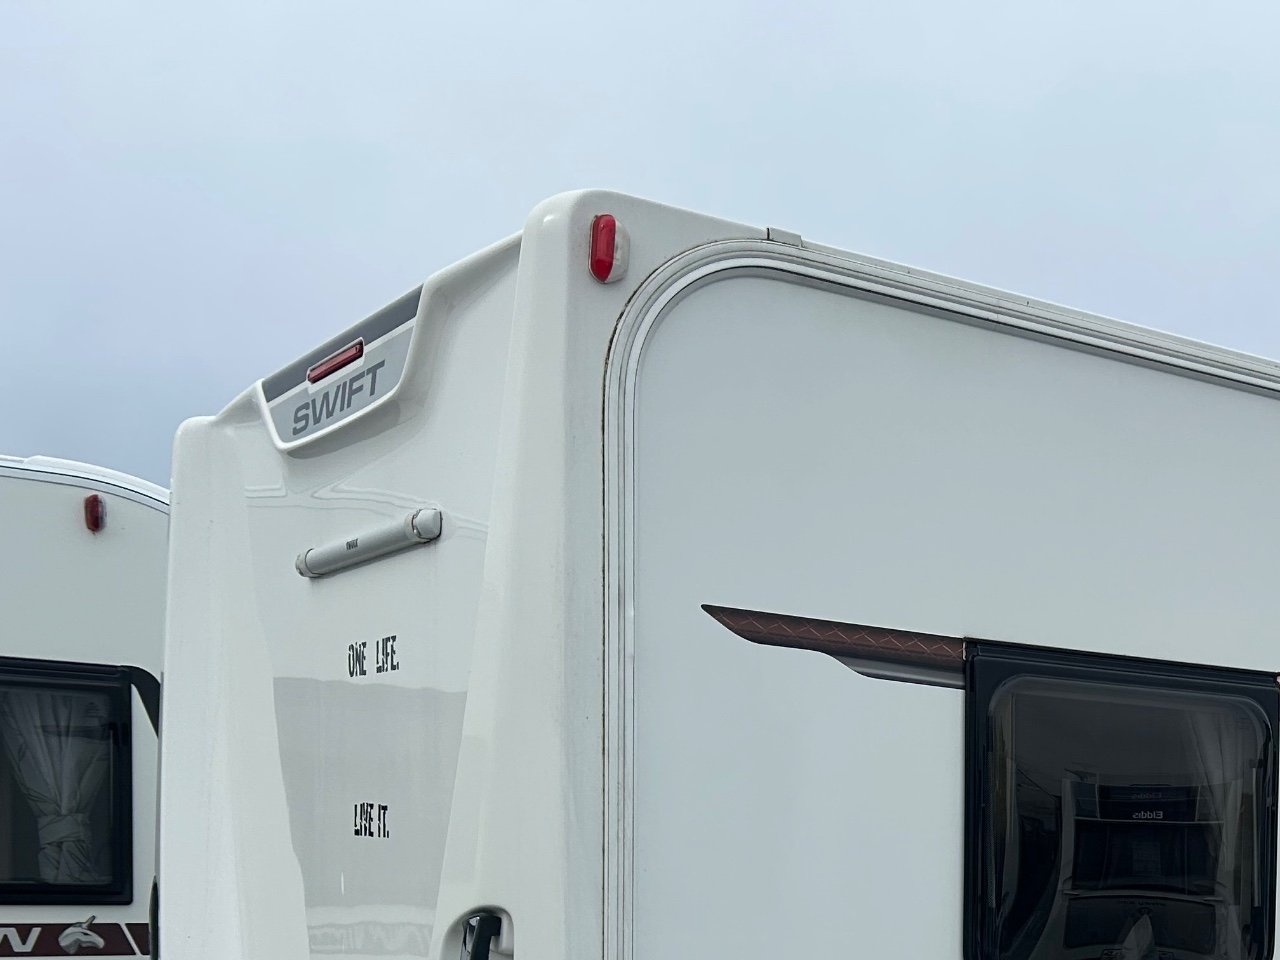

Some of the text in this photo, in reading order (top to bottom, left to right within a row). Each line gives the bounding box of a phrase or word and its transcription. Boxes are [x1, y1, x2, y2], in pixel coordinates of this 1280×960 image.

[292, 359, 386, 436] SWIFT
[348, 641, 367, 678] ONE
[354, 802, 374, 838] LIVE
